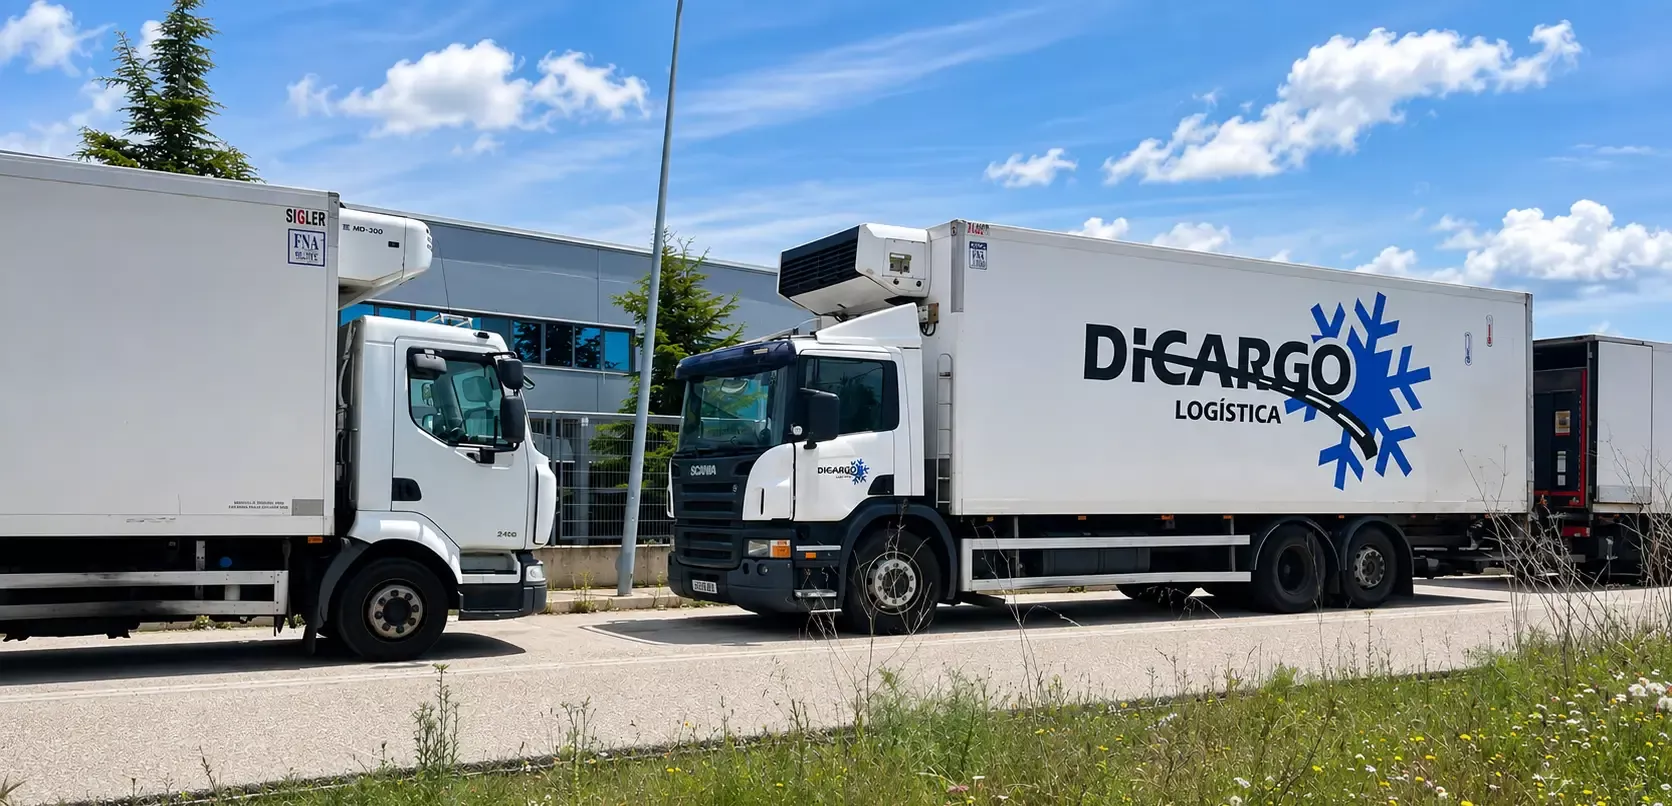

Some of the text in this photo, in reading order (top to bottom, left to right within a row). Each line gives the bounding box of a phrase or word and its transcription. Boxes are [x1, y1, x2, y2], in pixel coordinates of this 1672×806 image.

[286, 208, 326, 226] SIGLER
[294, 233, 319, 251] FNA
[1175, 398, 1282, 424] LOGÍSTICA
[690, 464, 717, 476] SCANIA
